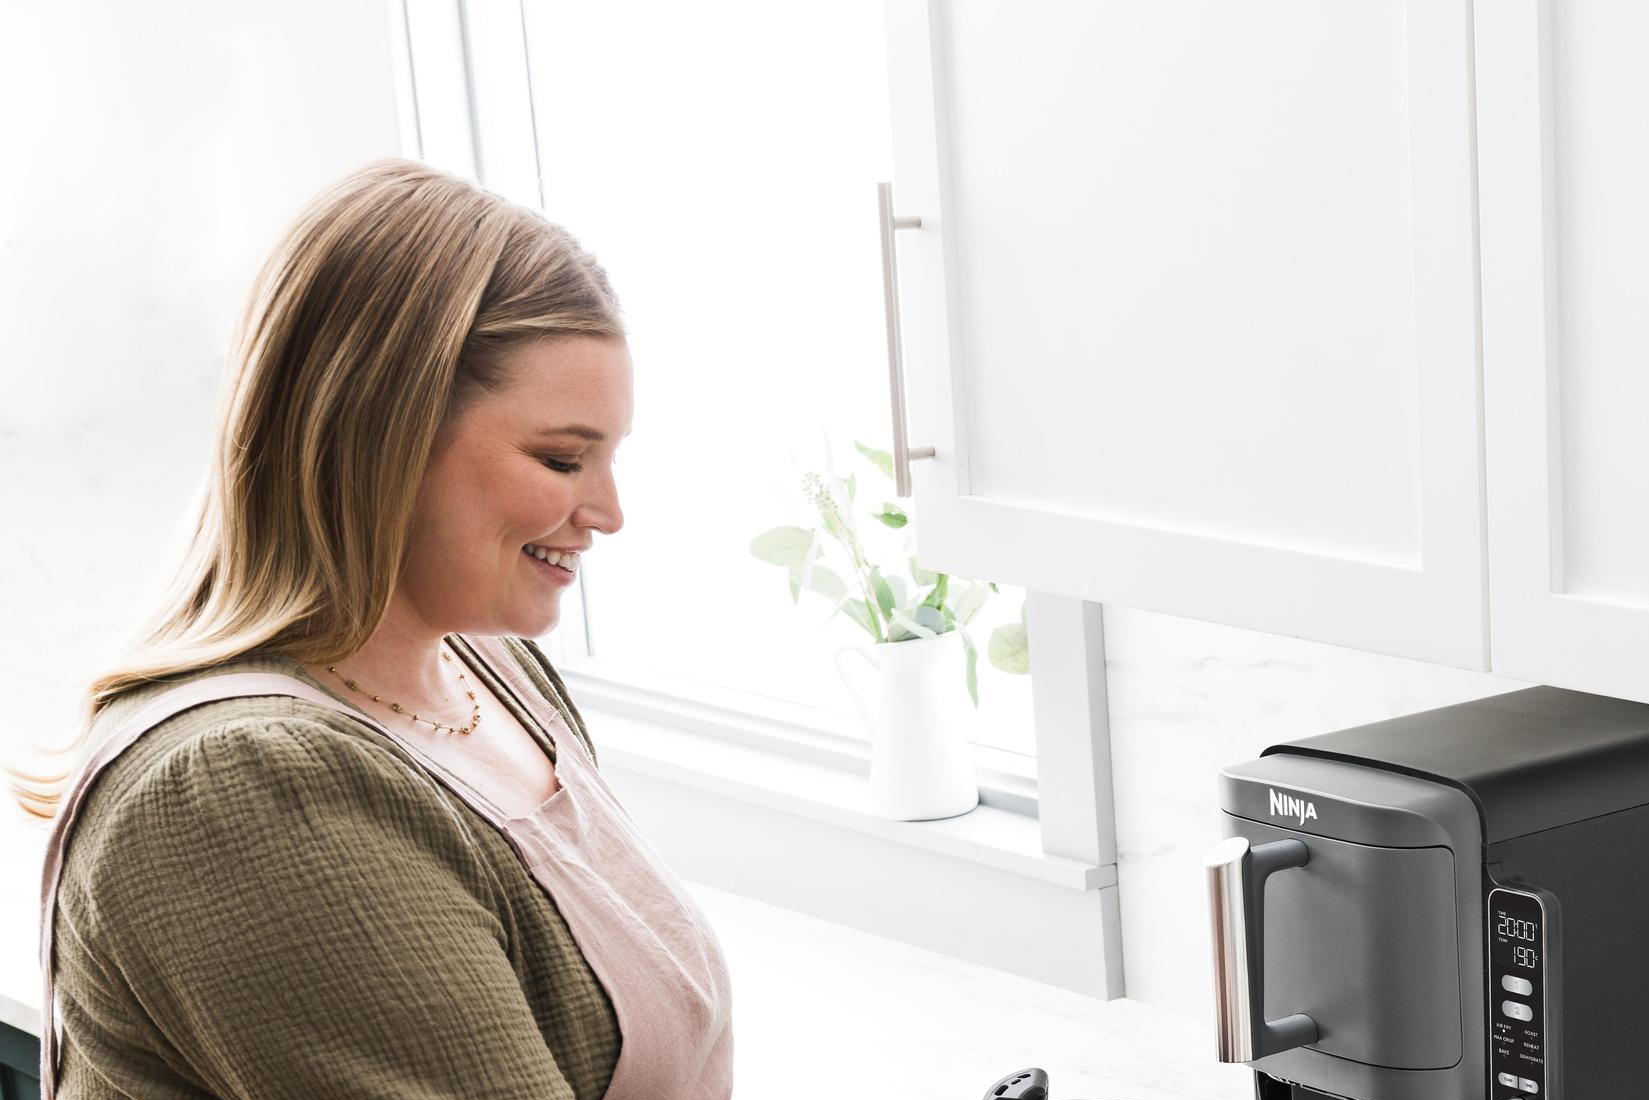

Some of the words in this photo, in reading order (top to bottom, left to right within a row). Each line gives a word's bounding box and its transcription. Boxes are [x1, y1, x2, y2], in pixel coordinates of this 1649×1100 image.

[1269, 788, 1318, 826] NINJA
[1497, 915, 1535, 942] 20:00
[1513, 946, 1535, 968] 190
[1524, 1029, 1539, 1037] ROAST
